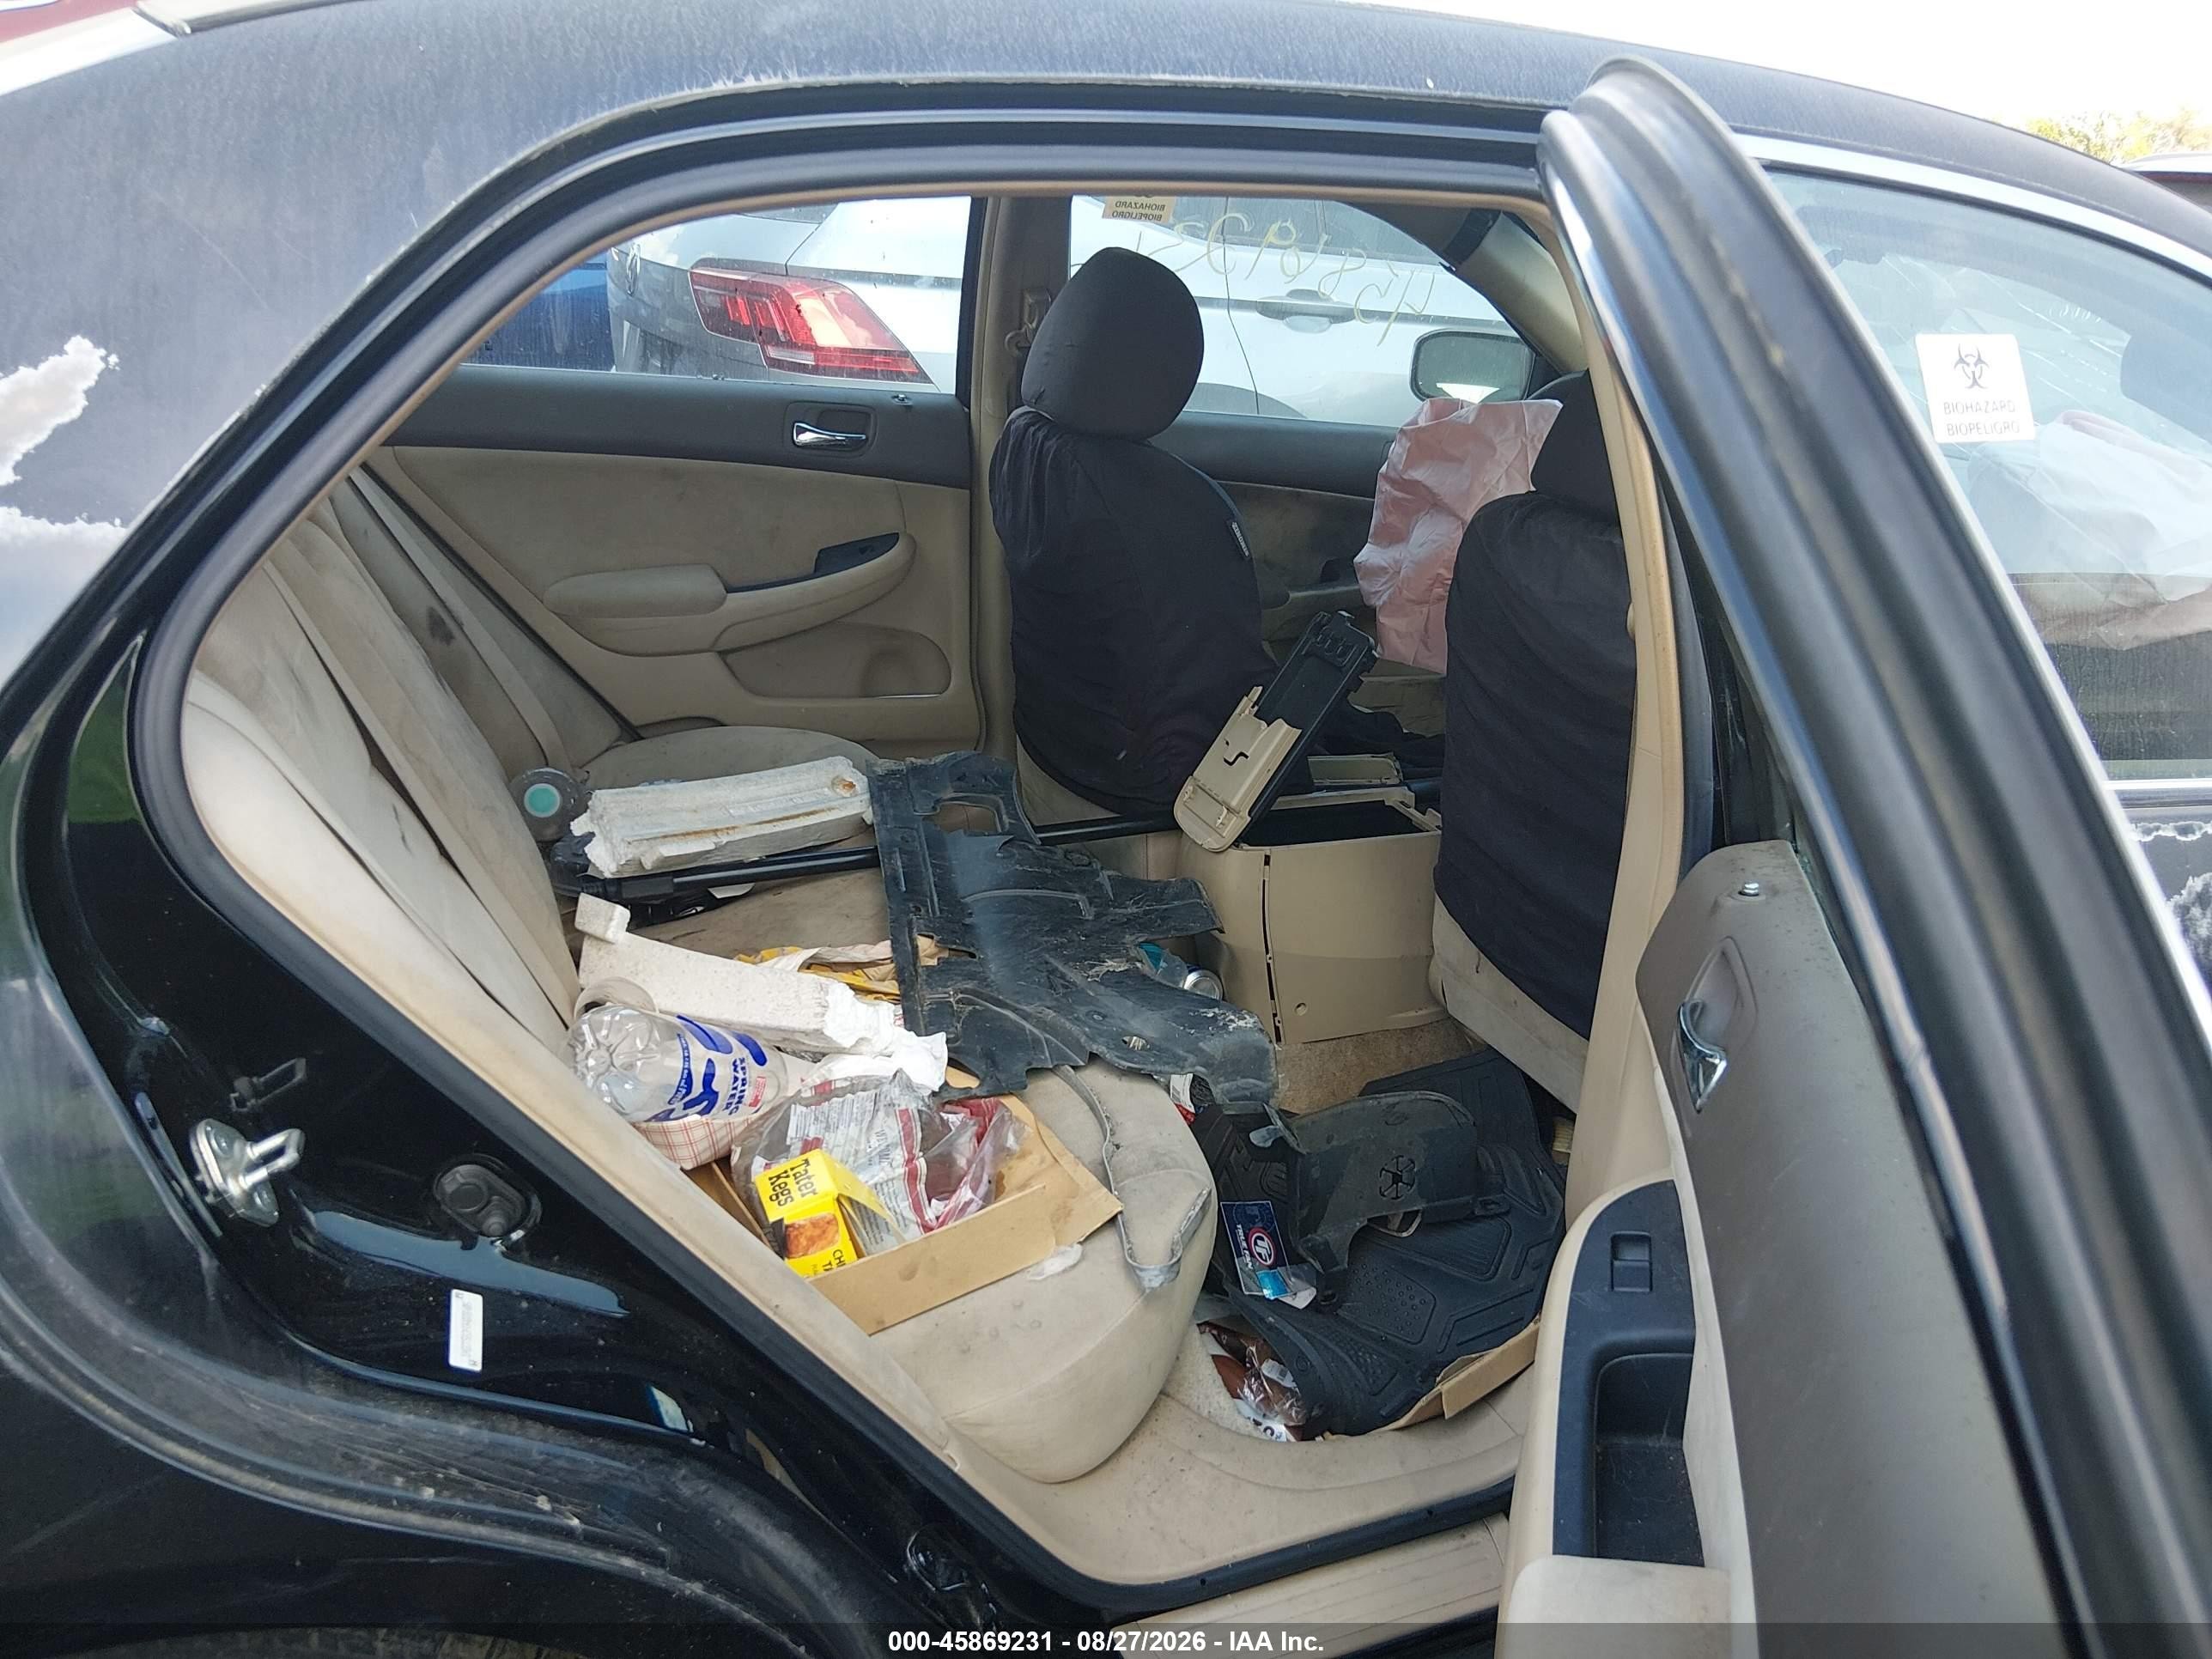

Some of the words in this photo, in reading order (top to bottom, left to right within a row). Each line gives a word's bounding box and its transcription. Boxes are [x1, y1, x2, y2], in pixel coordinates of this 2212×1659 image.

[1944, 401, 2015, 415] BIOHAZARD
[1948, 422, 2020, 436] BIOPELIGRO
[722, 1058, 738, 1111] WATER
[729, 1057, 748, 1115] SPRING
[769, 1170, 795, 1206] Kegs
[790, 1158, 818, 1198] Tater
[1237, 1224, 1248, 1249] TRUE
[1243, 1249, 1254, 1269] FAN
